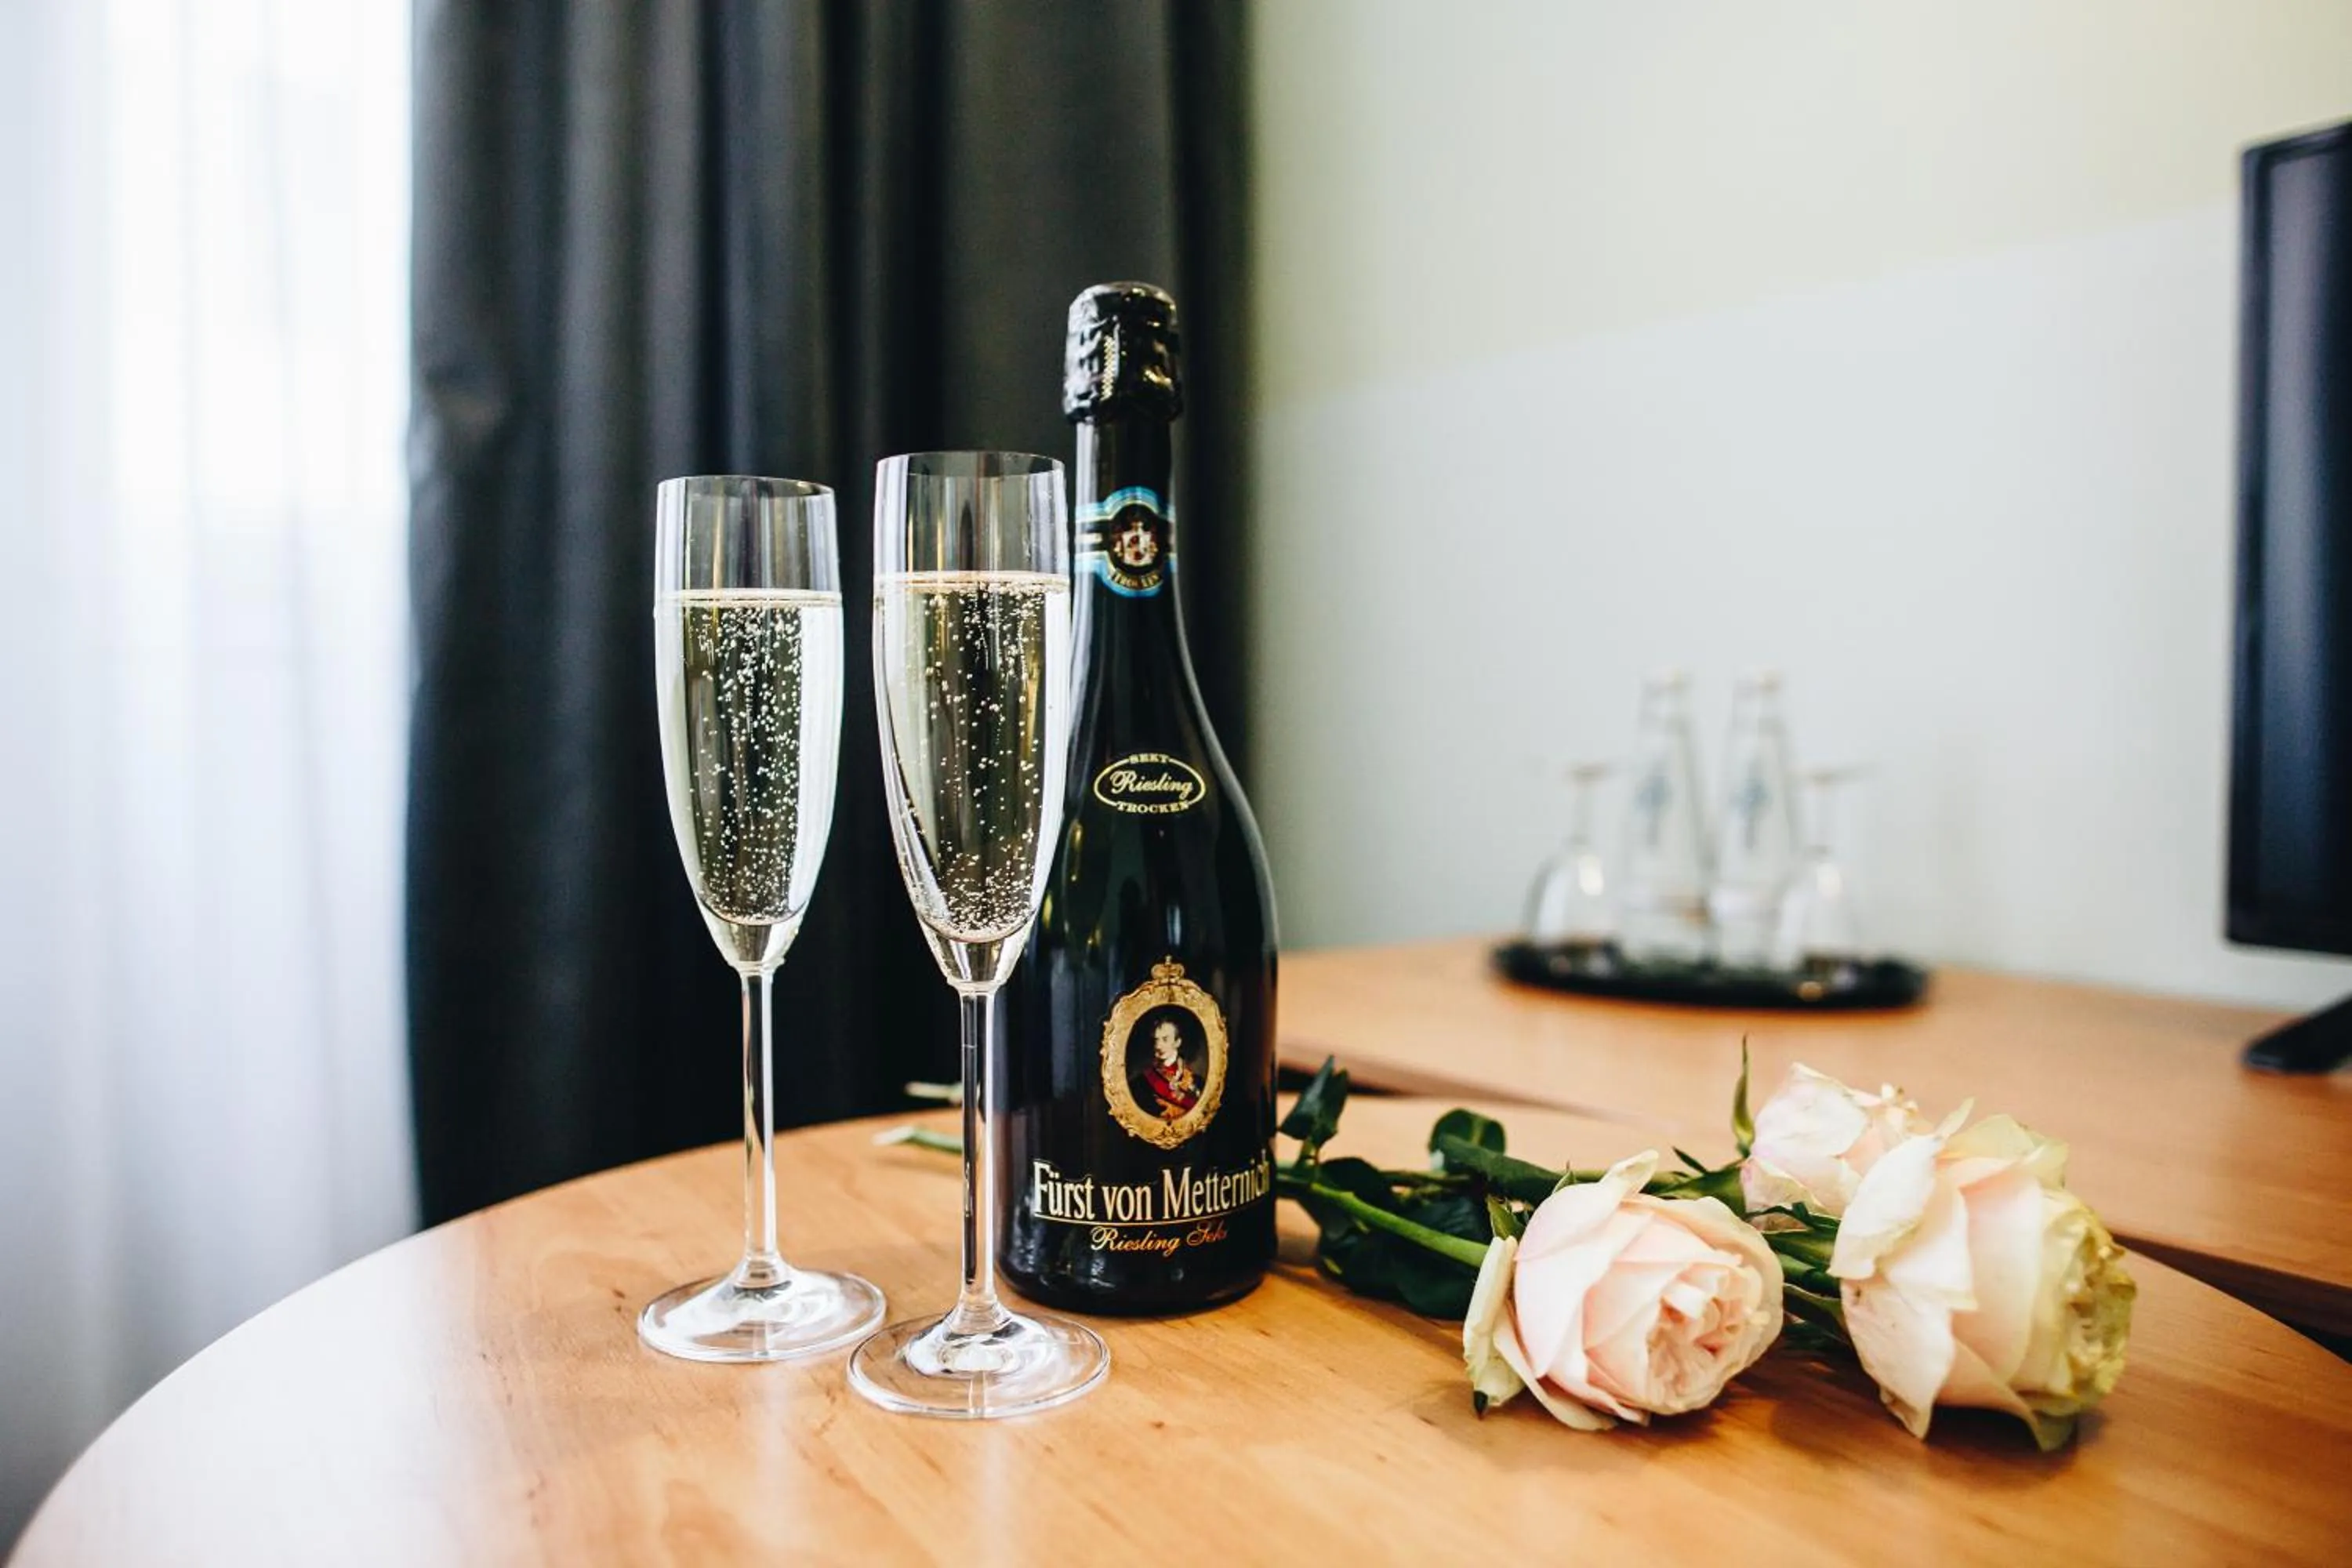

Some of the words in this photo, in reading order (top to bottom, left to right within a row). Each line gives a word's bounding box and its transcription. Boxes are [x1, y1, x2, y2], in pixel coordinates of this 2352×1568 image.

[1128, 753, 1170, 764] SEKT
[1110, 770, 1193, 800] Riesling
[1116, 800, 1190, 813] TROCKEN
[1033, 1161, 1095, 1220] Fürst
[1102, 1185, 1153, 1221] von
[1162, 1149, 1269, 1219] Metternich
[1091, 1225, 1181, 1257] Riesling
